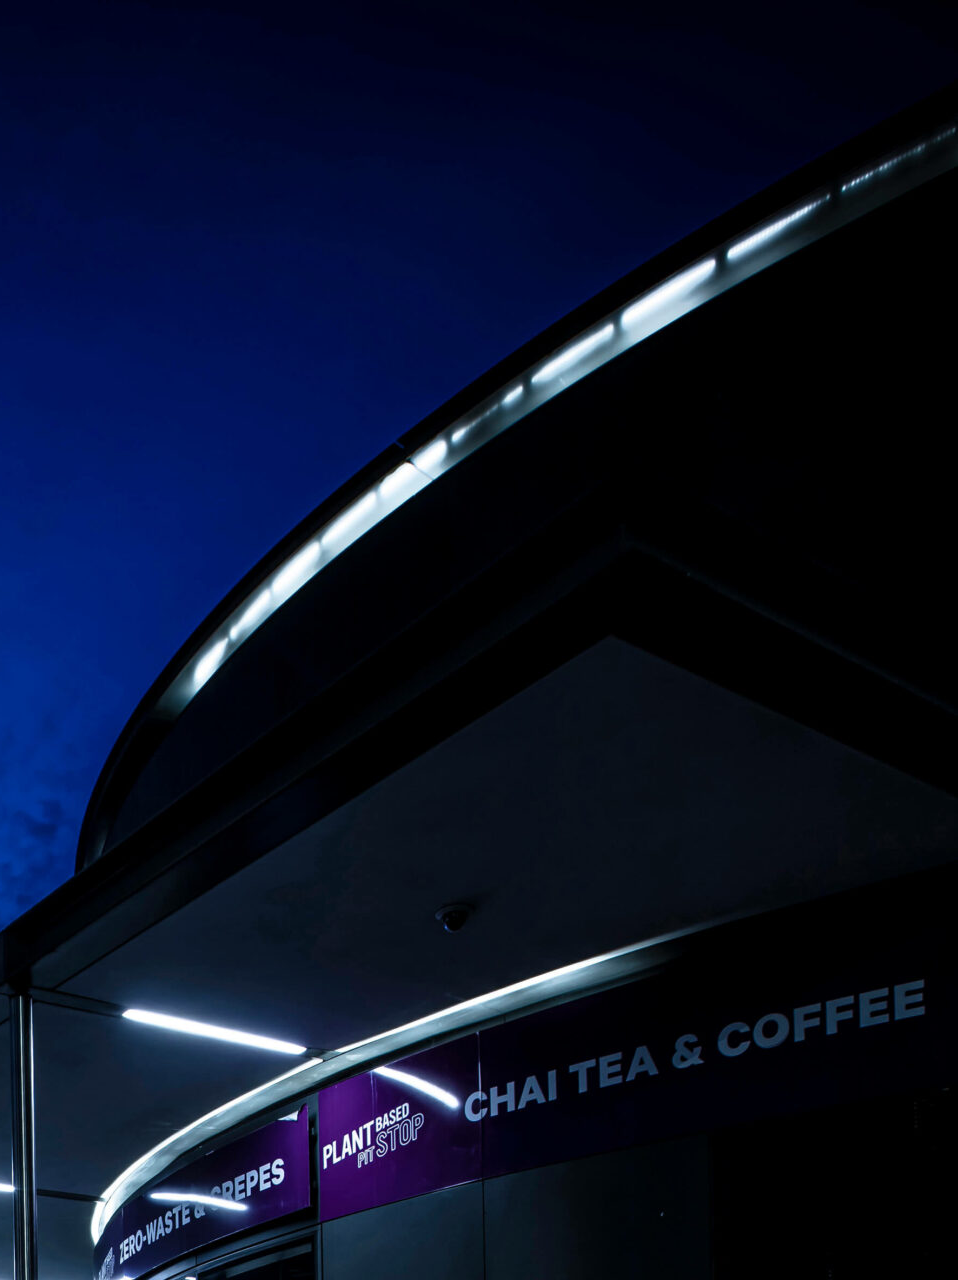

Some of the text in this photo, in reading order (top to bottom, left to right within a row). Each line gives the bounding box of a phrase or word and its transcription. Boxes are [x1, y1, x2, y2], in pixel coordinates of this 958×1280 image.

[464, 979, 926, 1122] CHAI TEA & COFFEE
[322, 1102, 410, 1170] PLANT BASED
[357, 1112, 424, 1168] PIT STOP
[119, 1203, 191, 1265] ZERO-WASTE
[193, 1201, 206, 1219] &
[210, 1158, 286, 1210] CREPES
